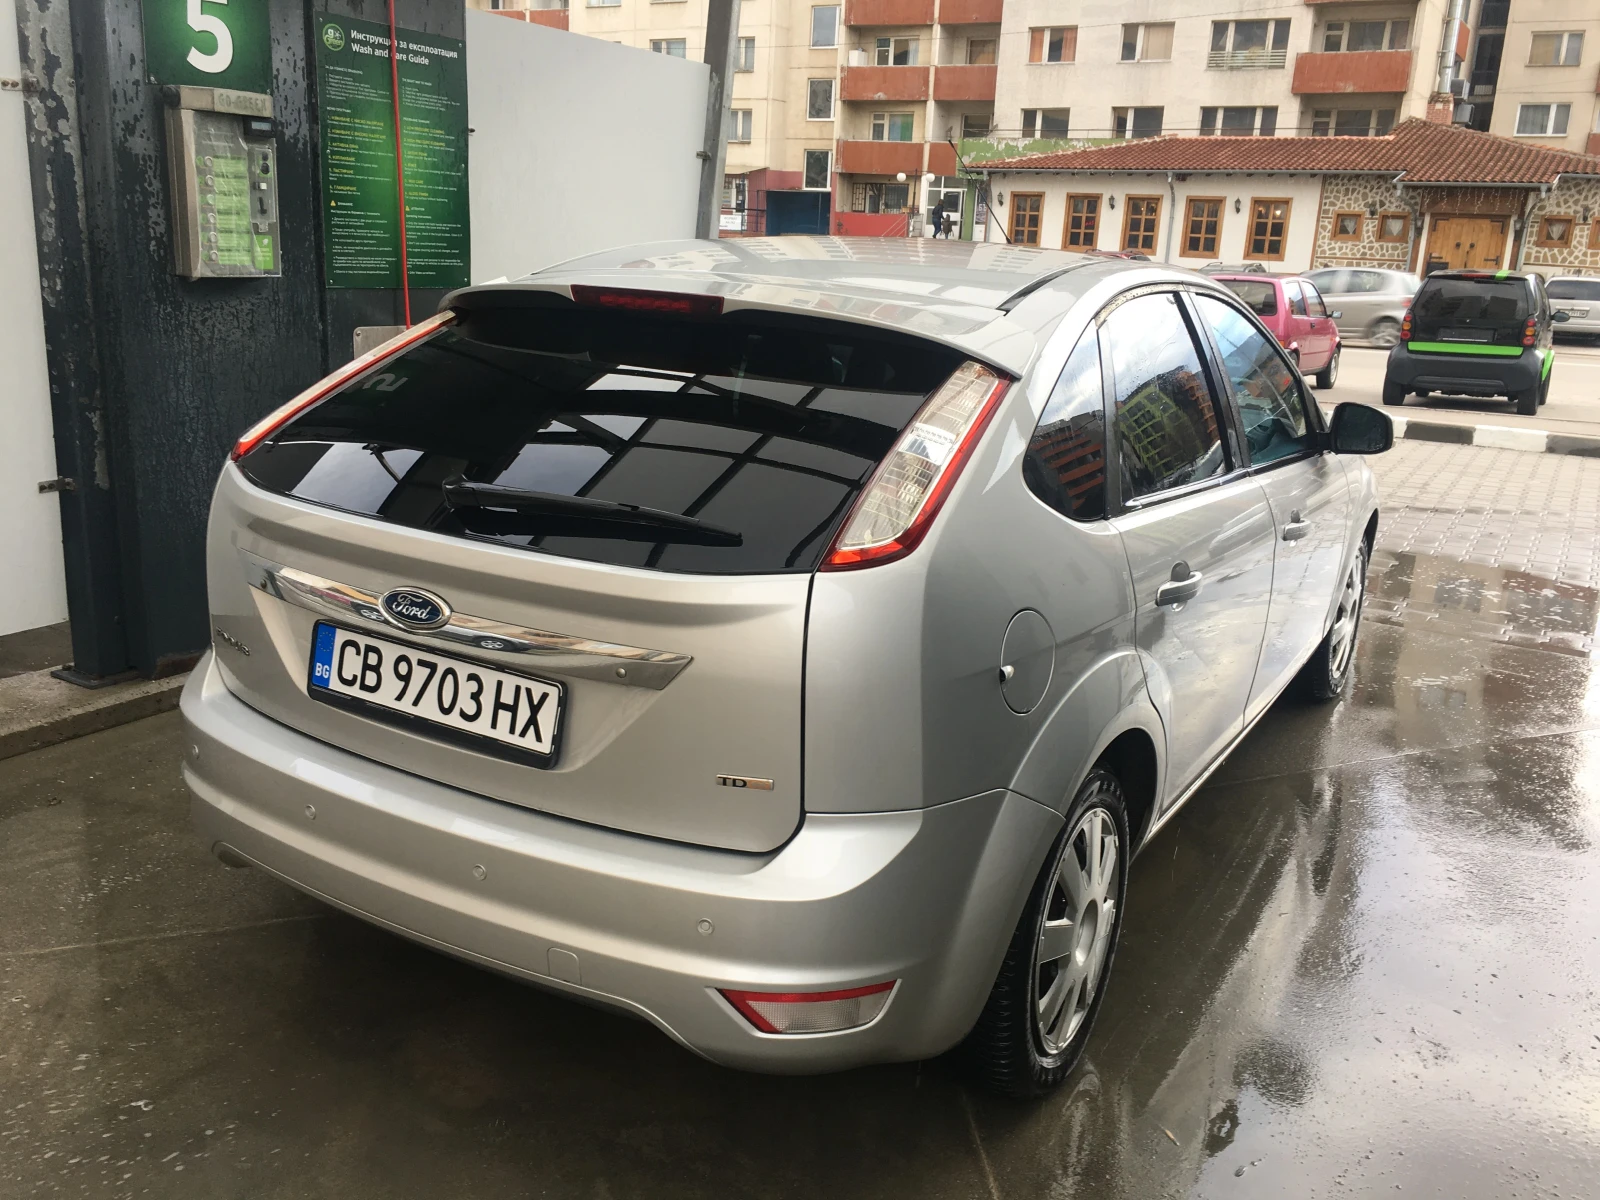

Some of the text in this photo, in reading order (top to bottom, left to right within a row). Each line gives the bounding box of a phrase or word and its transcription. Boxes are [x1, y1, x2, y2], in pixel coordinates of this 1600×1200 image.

[187, 0, 233, 73] 5
[351, 42, 429, 65] Wash and are Guide
[409, 44, 458, 58] експлоатация
[392, 593, 431, 622] Ford
[315, 662, 330, 679] BG
[337, 638, 550, 743] CB 9703 HX
